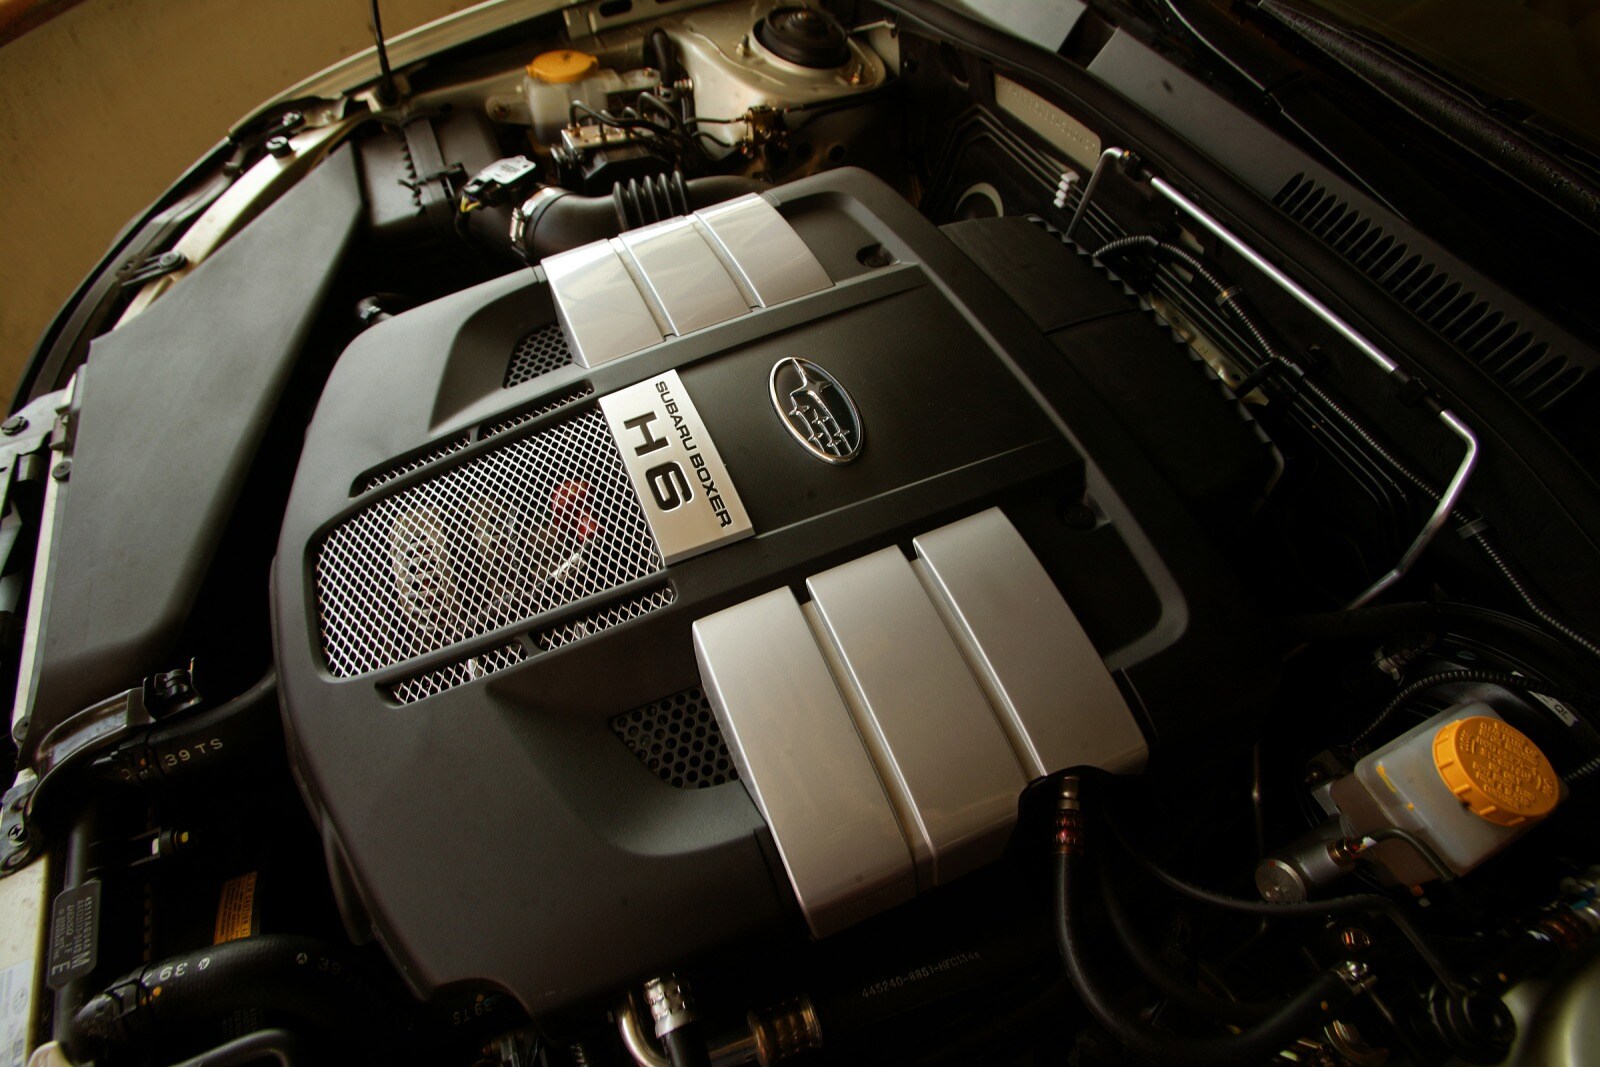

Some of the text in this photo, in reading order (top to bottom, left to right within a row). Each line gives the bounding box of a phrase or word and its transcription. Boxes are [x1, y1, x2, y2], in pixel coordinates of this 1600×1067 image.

[623, 411, 694, 512] H6
[655, 381, 732, 528] SUBARU BOXER
[165, 738, 223, 766] 39 TS
